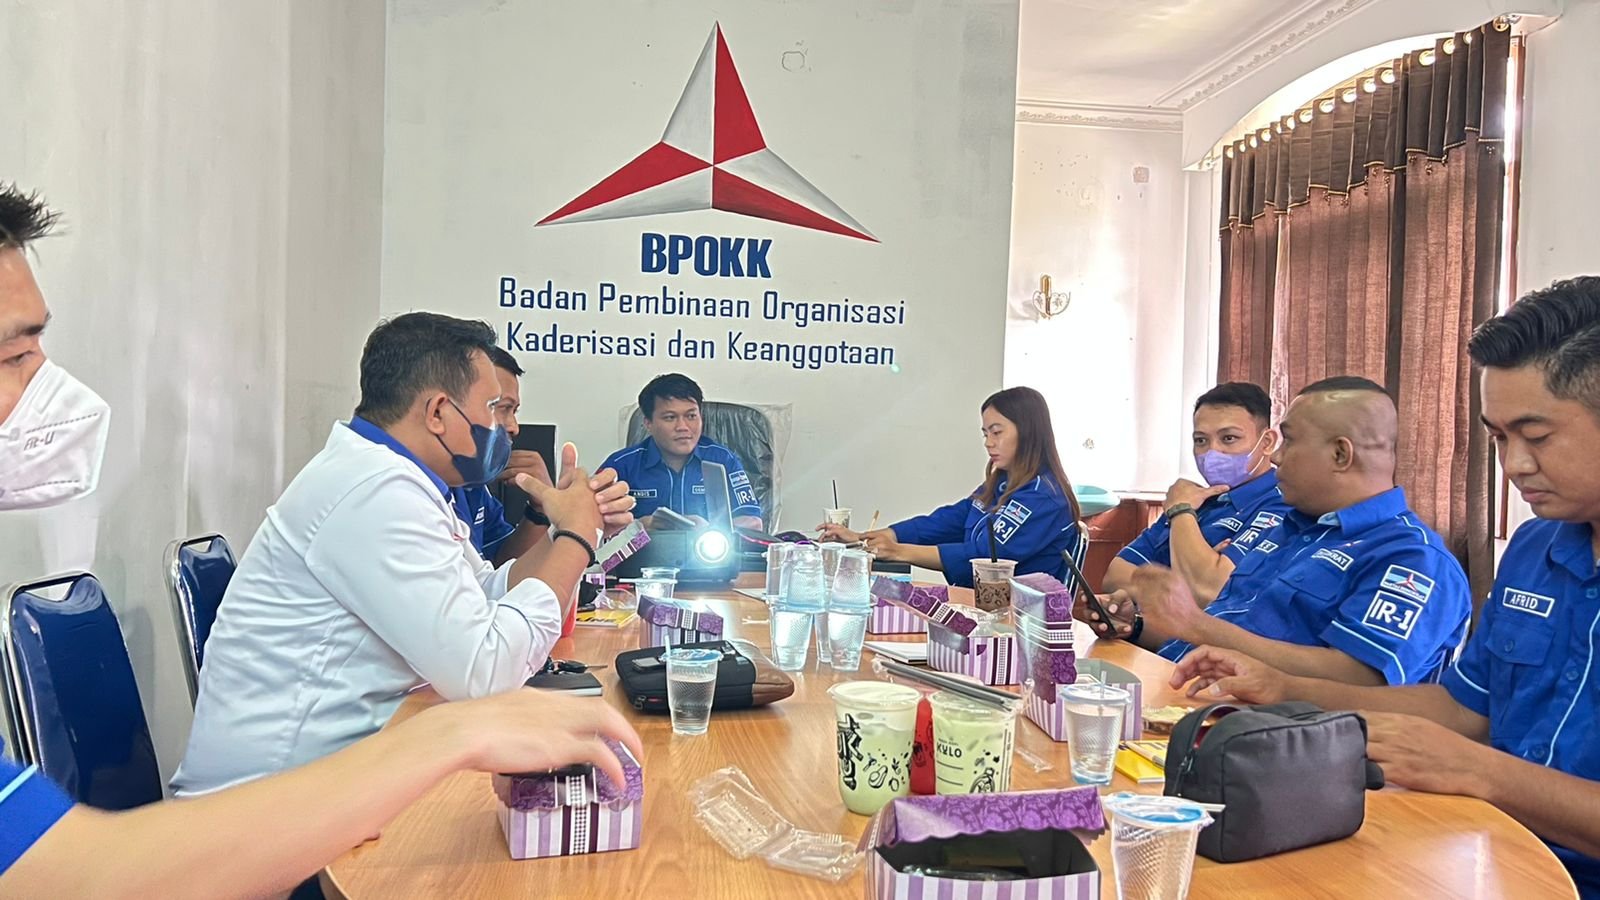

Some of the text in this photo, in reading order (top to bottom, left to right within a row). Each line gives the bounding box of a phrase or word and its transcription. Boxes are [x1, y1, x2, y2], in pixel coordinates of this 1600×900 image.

[642, 233, 772, 278] BPOKK
[500, 278, 903, 327] Badan Pembinaan Organisasi
[508, 322, 893, 369] Kaderisasi dan Keanggotaan
[1369, 598, 1414, 631] IR-1
[1509, 593, 1538, 610] AFRID
